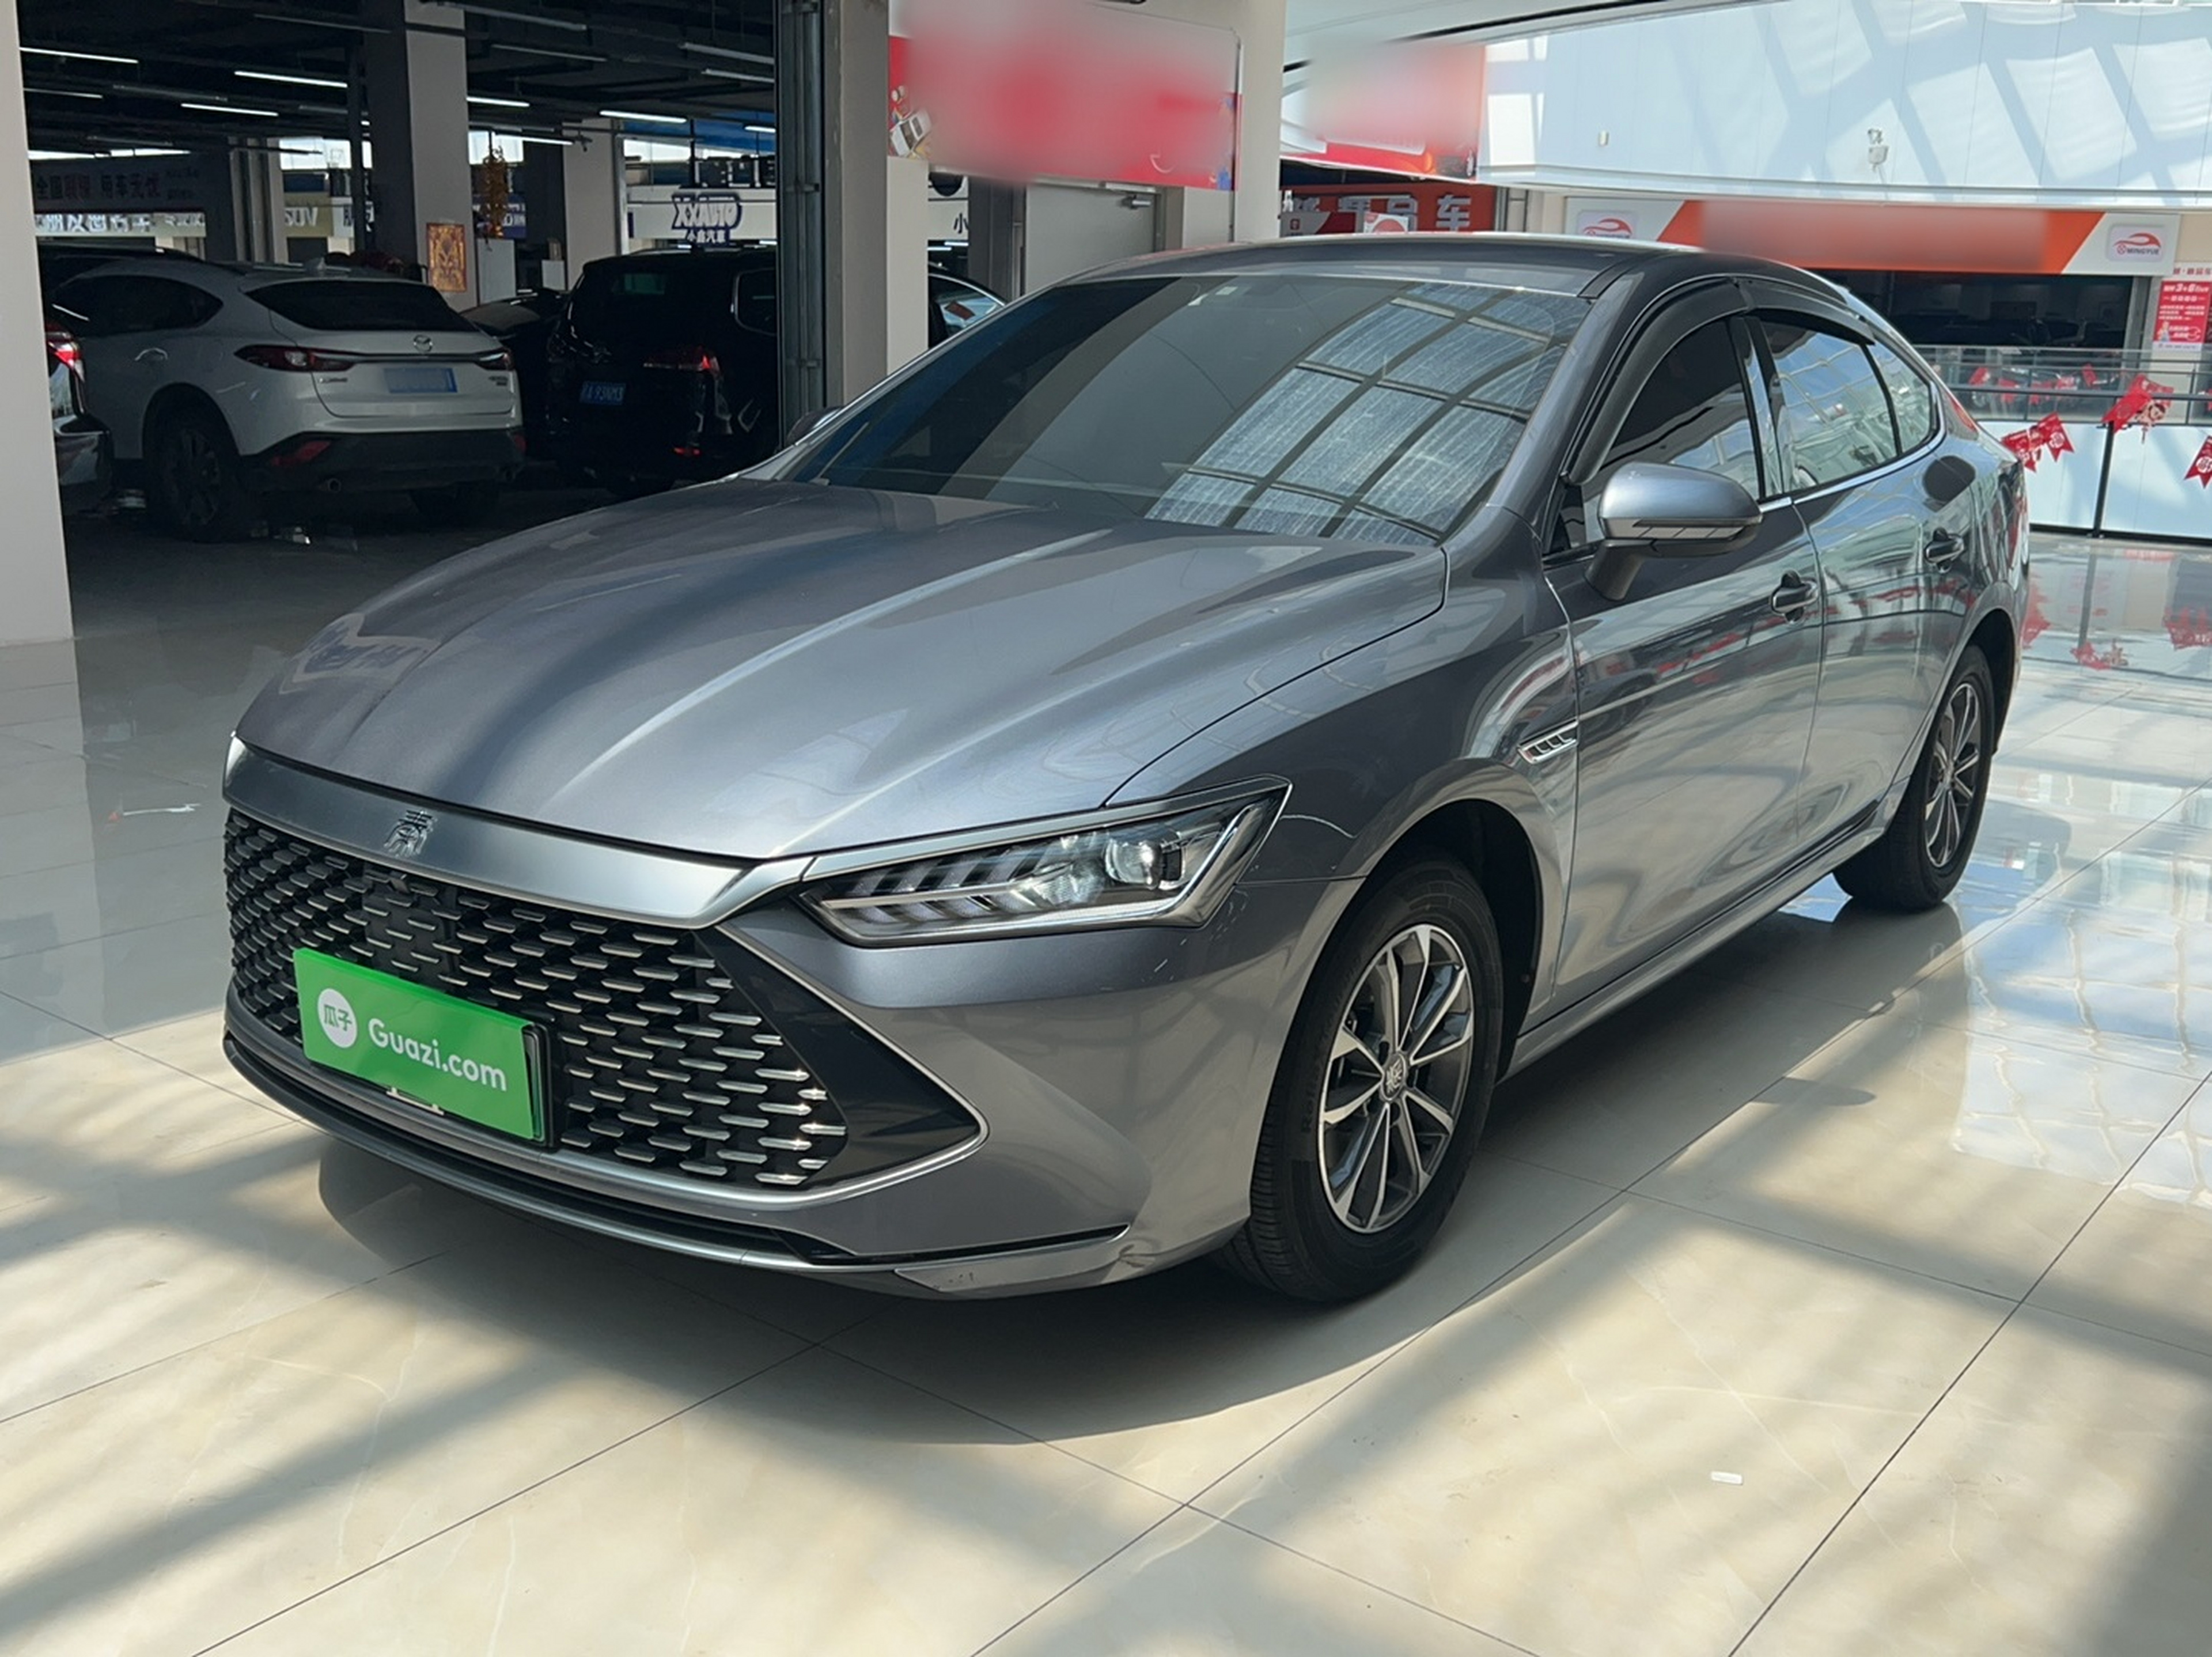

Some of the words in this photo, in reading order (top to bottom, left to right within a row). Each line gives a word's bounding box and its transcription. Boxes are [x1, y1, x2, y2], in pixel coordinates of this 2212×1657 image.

[284, 206, 319, 226] SUV
[323, 1003, 353, 1032] 瓜子
[368, 1018, 507, 1091] Guazi.com
